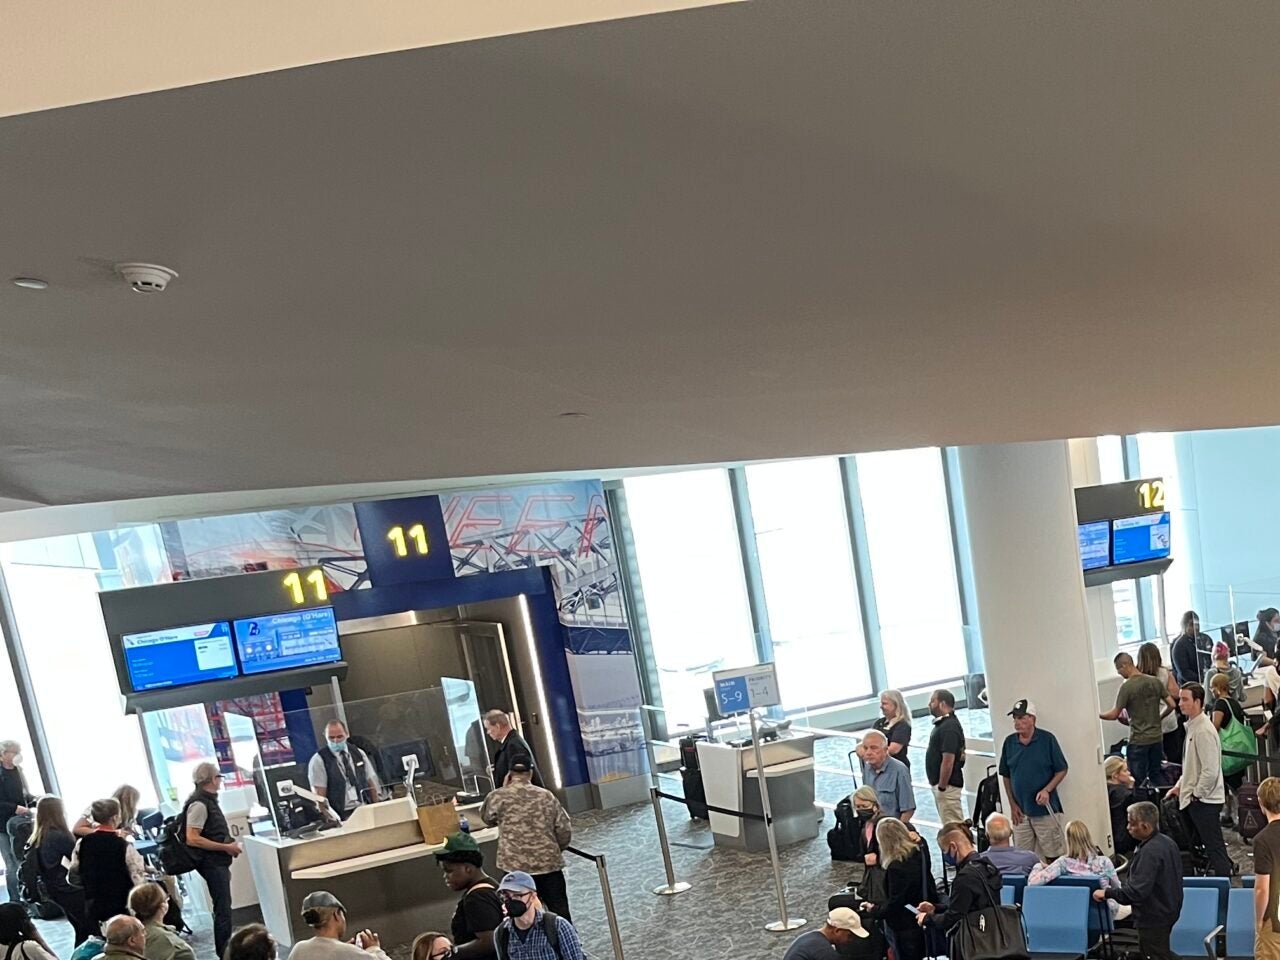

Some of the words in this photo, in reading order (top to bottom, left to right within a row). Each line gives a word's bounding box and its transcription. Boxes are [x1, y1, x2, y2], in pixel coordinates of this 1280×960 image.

[1138, 480, 1164, 508] 12
[387, 523, 429, 558] 11
[283, 568, 329, 605] 11
